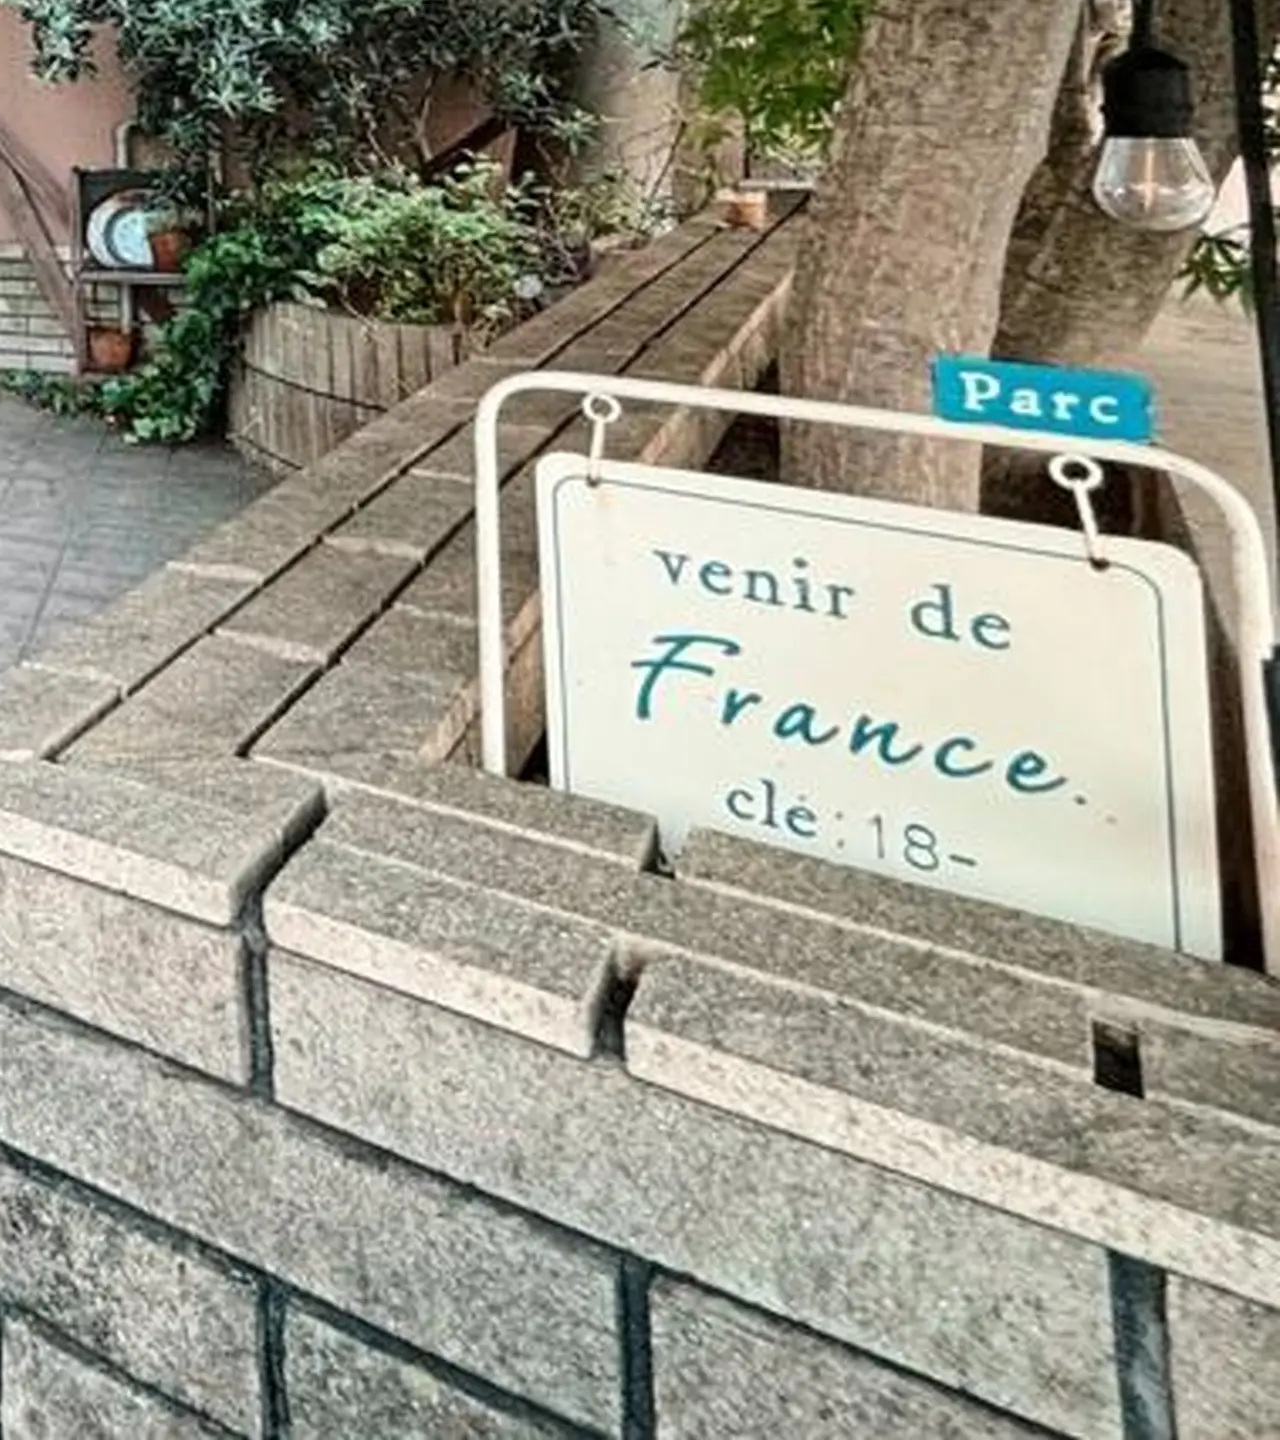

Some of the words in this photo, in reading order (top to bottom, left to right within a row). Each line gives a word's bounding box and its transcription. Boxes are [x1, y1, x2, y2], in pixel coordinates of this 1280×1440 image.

[959, 371, 1120, 424] Parc
[653, 549, 856, 619] venir
[910, 584, 1012, 651] de
